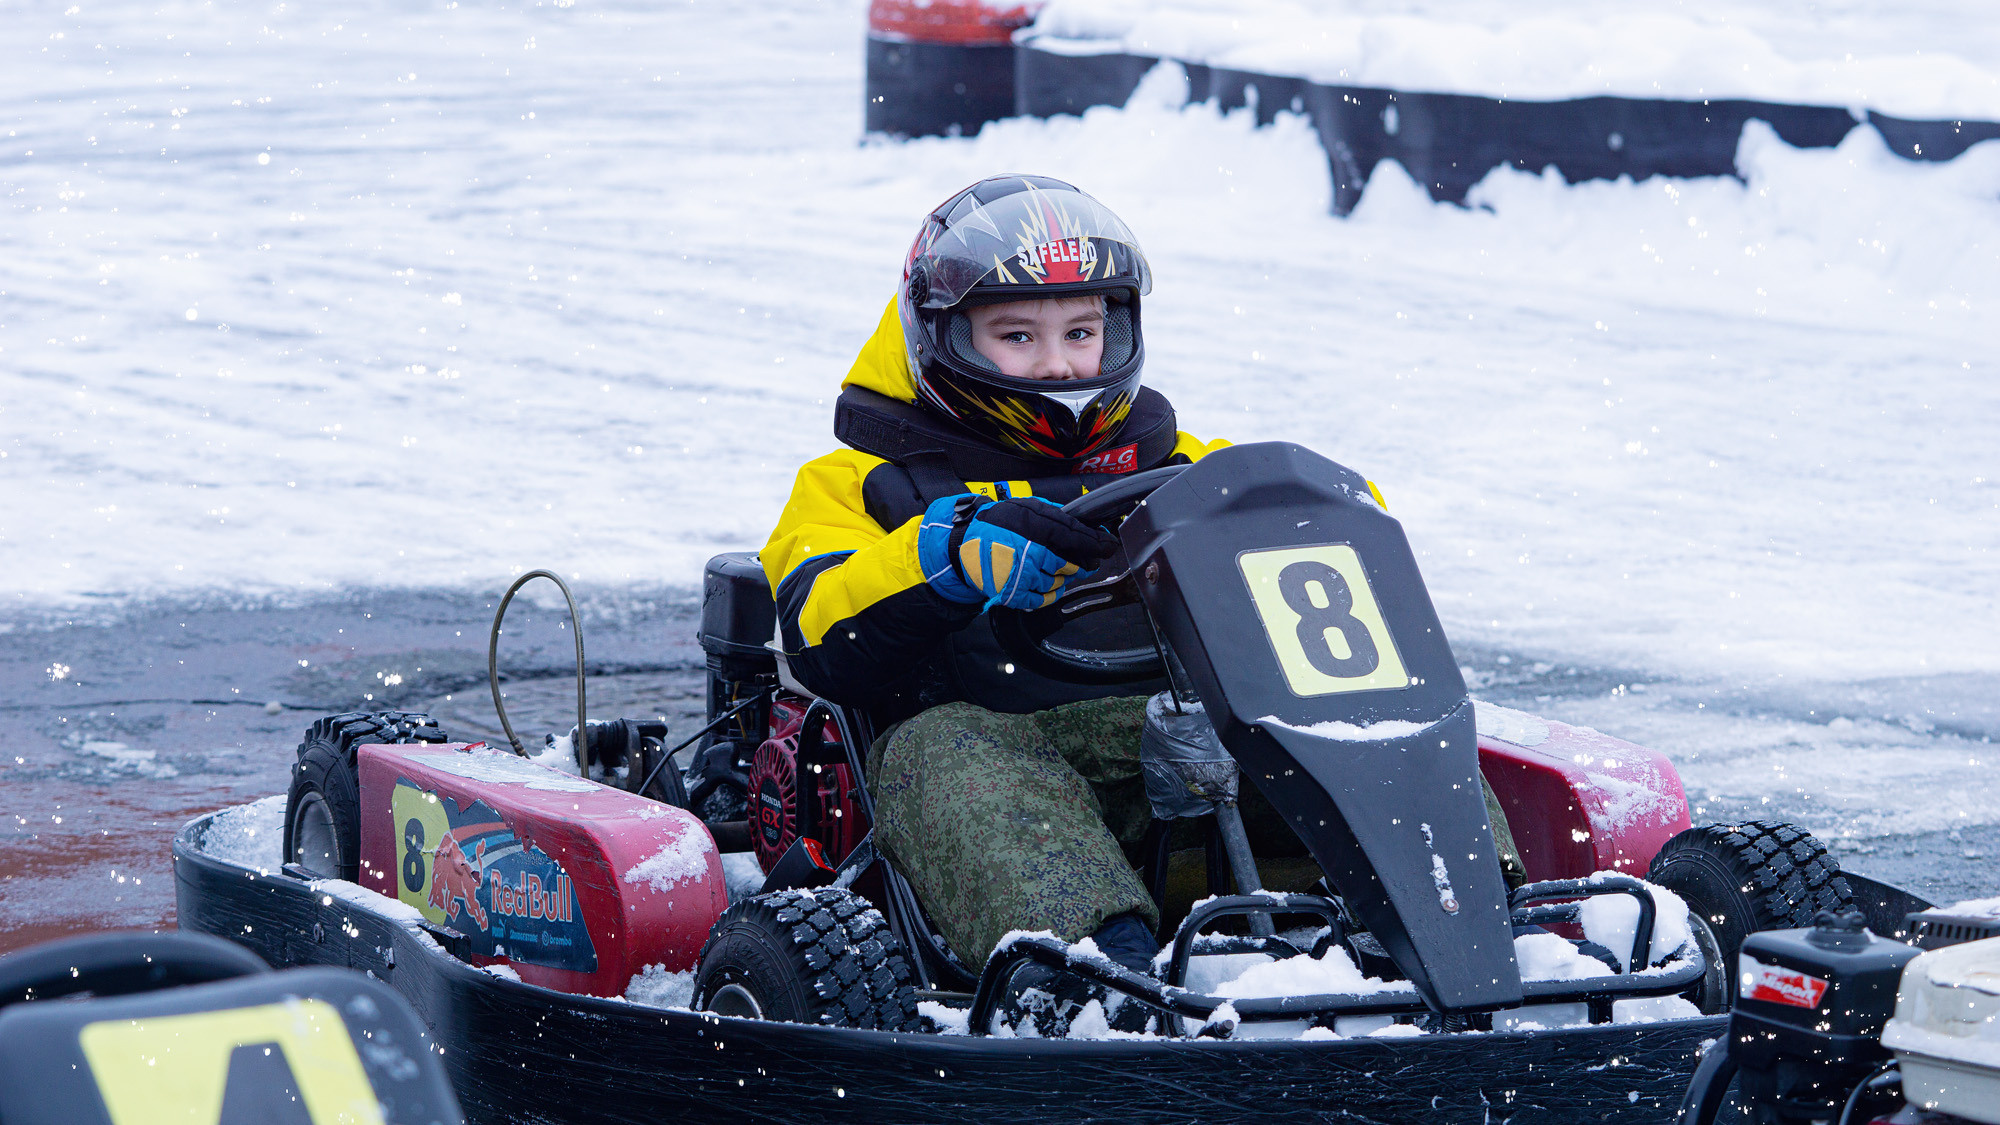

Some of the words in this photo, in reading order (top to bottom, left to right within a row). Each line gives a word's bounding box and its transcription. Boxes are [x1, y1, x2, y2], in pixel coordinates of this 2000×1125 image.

[1016, 240, 1098, 268] SAFELEAD
[1079, 449, 1134, 471] RLG
[1277, 560, 1380, 679] 8
[761, 792, 782, 809] HONDA
[761, 806, 781, 829] GX
[403, 817, 425, 893] 8
